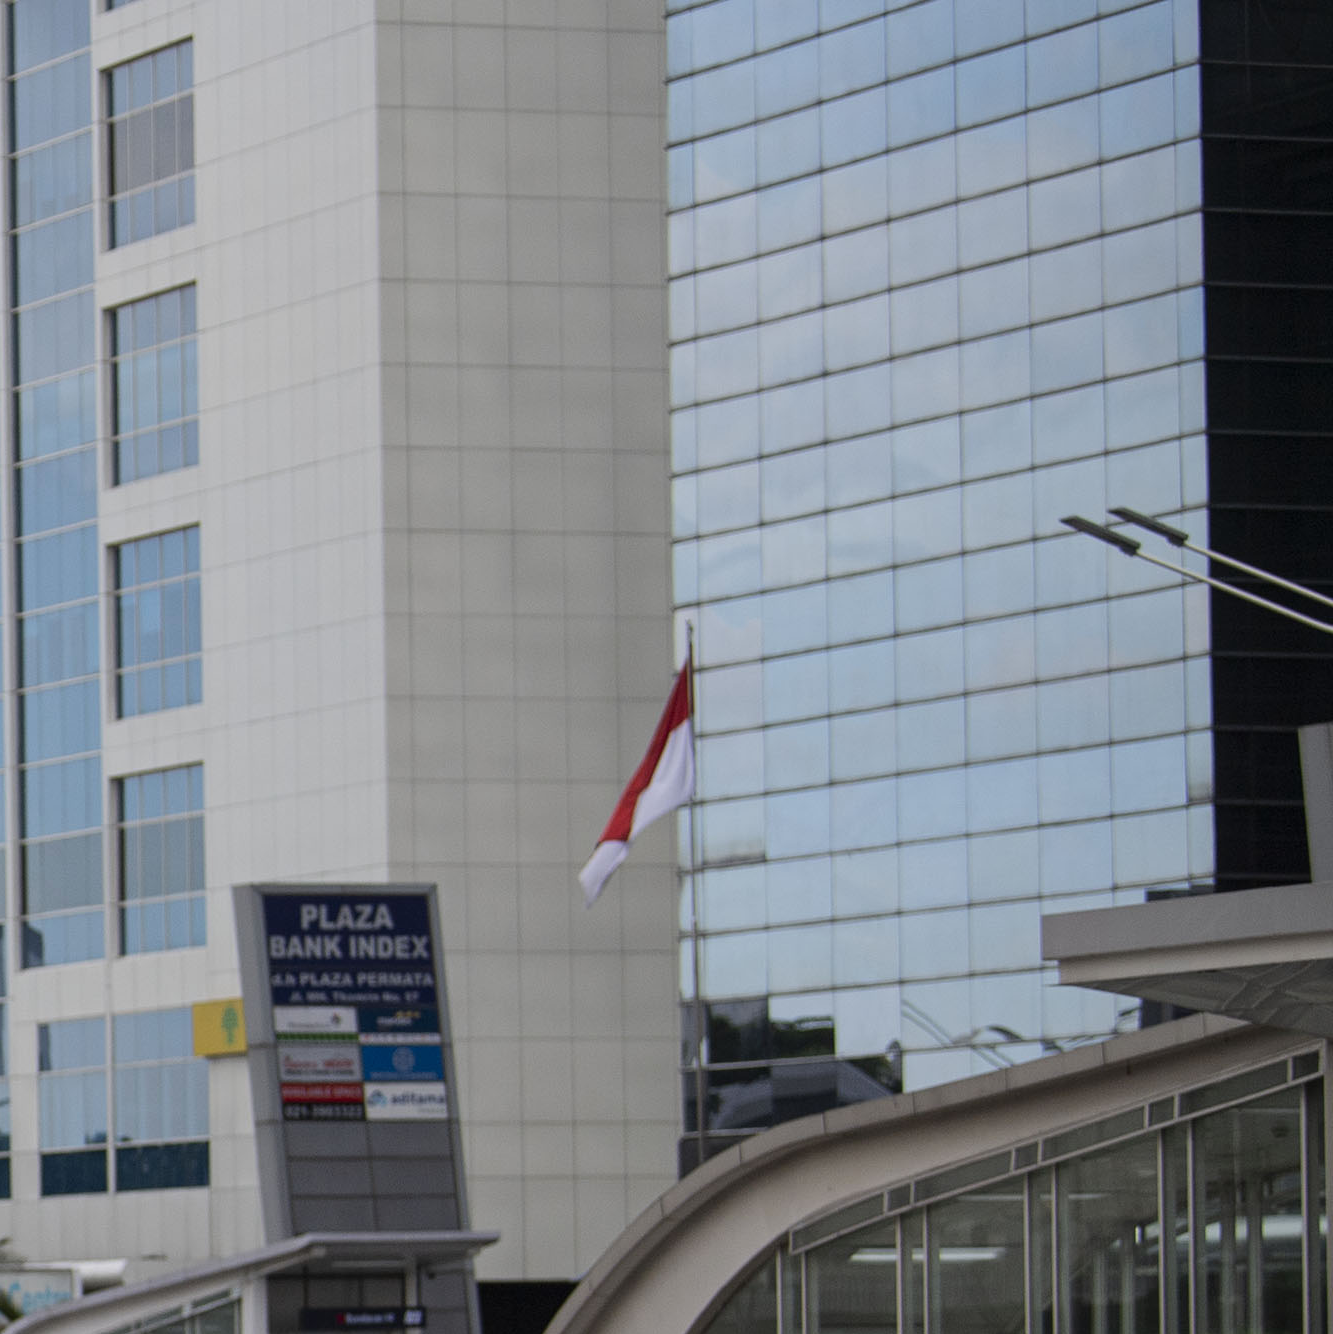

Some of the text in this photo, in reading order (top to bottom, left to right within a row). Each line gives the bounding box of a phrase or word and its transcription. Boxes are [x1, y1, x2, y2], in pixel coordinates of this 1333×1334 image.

[300, 904, 394, 930] PLAZA
[270, 935, 429, 960] BANK INDEX
[299, 972, 352, 986] PLAZA
[357, 972, 433, 986] PERMATA
[392, 1089, 444, 1104] aditama
